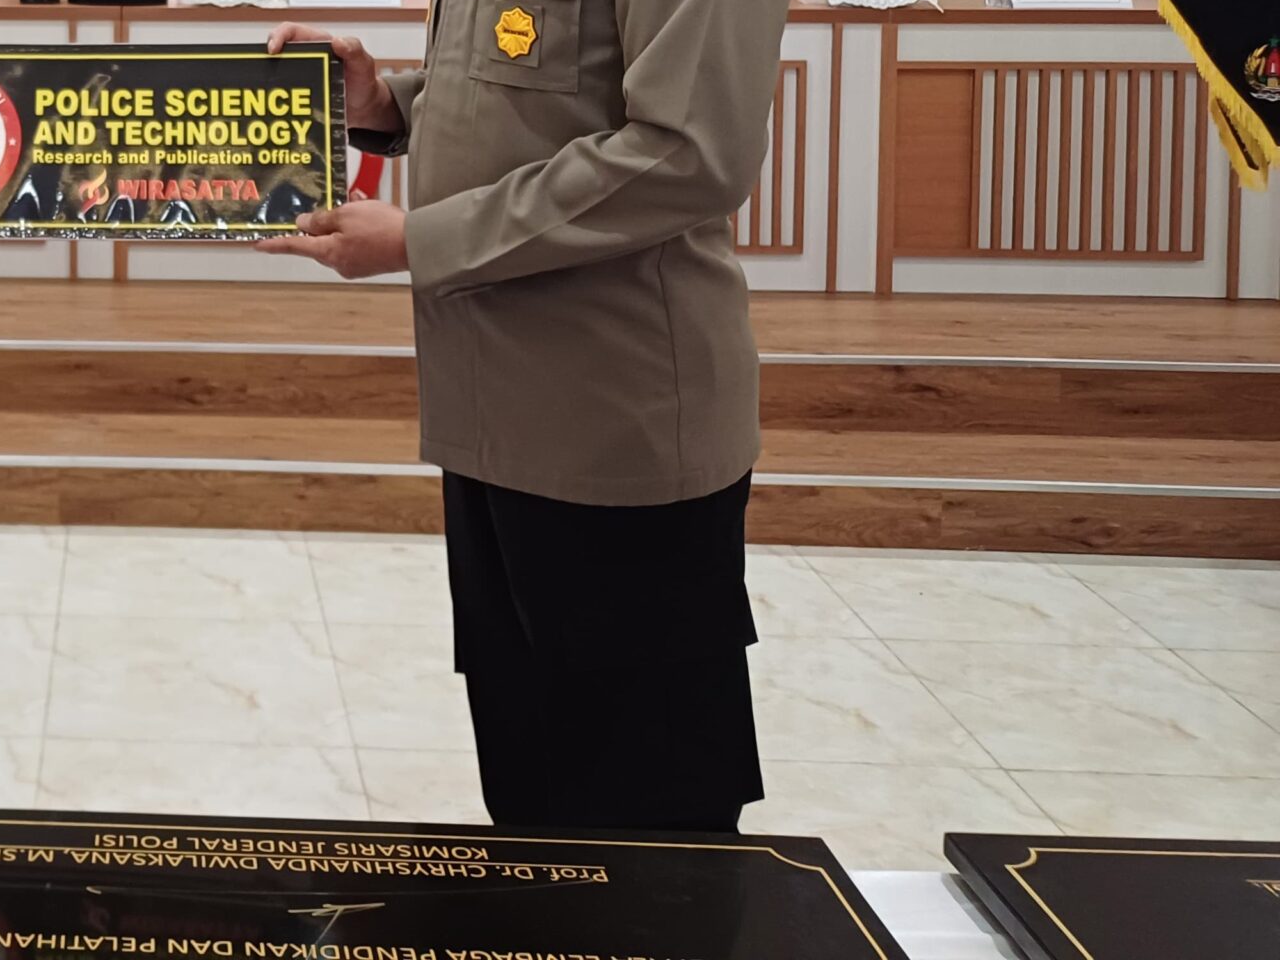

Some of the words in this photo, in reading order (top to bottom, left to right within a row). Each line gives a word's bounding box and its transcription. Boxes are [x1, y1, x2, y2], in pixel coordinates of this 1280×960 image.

[34, 88, 154, 118] POLICE
[164, 88, 311, 117] SCIENCE
[34, 121, 99, 146] AND
[105, 120, 313, 147] TECHNOLOGY
[32, 150, 112, 165] Research
[117, 150, 149, 165] and
[155, 150, 253, 165] Publication
[258, 149, 312, 165] Office
[118, 179, 260, 201] WIRASATYA
[94, 834, 178, 850] POLISI
[186, 837, 326, 854] JENDERAL
[63, 849, 258, 870] DWILAKSANA,
[334, 843, 489, 860] KOMISARIS
[266, 858, 487, 878] CHRYSHNANDA
[495, 865, 534, 880] Dr.
[542, 867, 609, 883] Prof.
[168, 938, 233, 956] DAN
[244, 942, 437, 960] PENDIDIKAN
